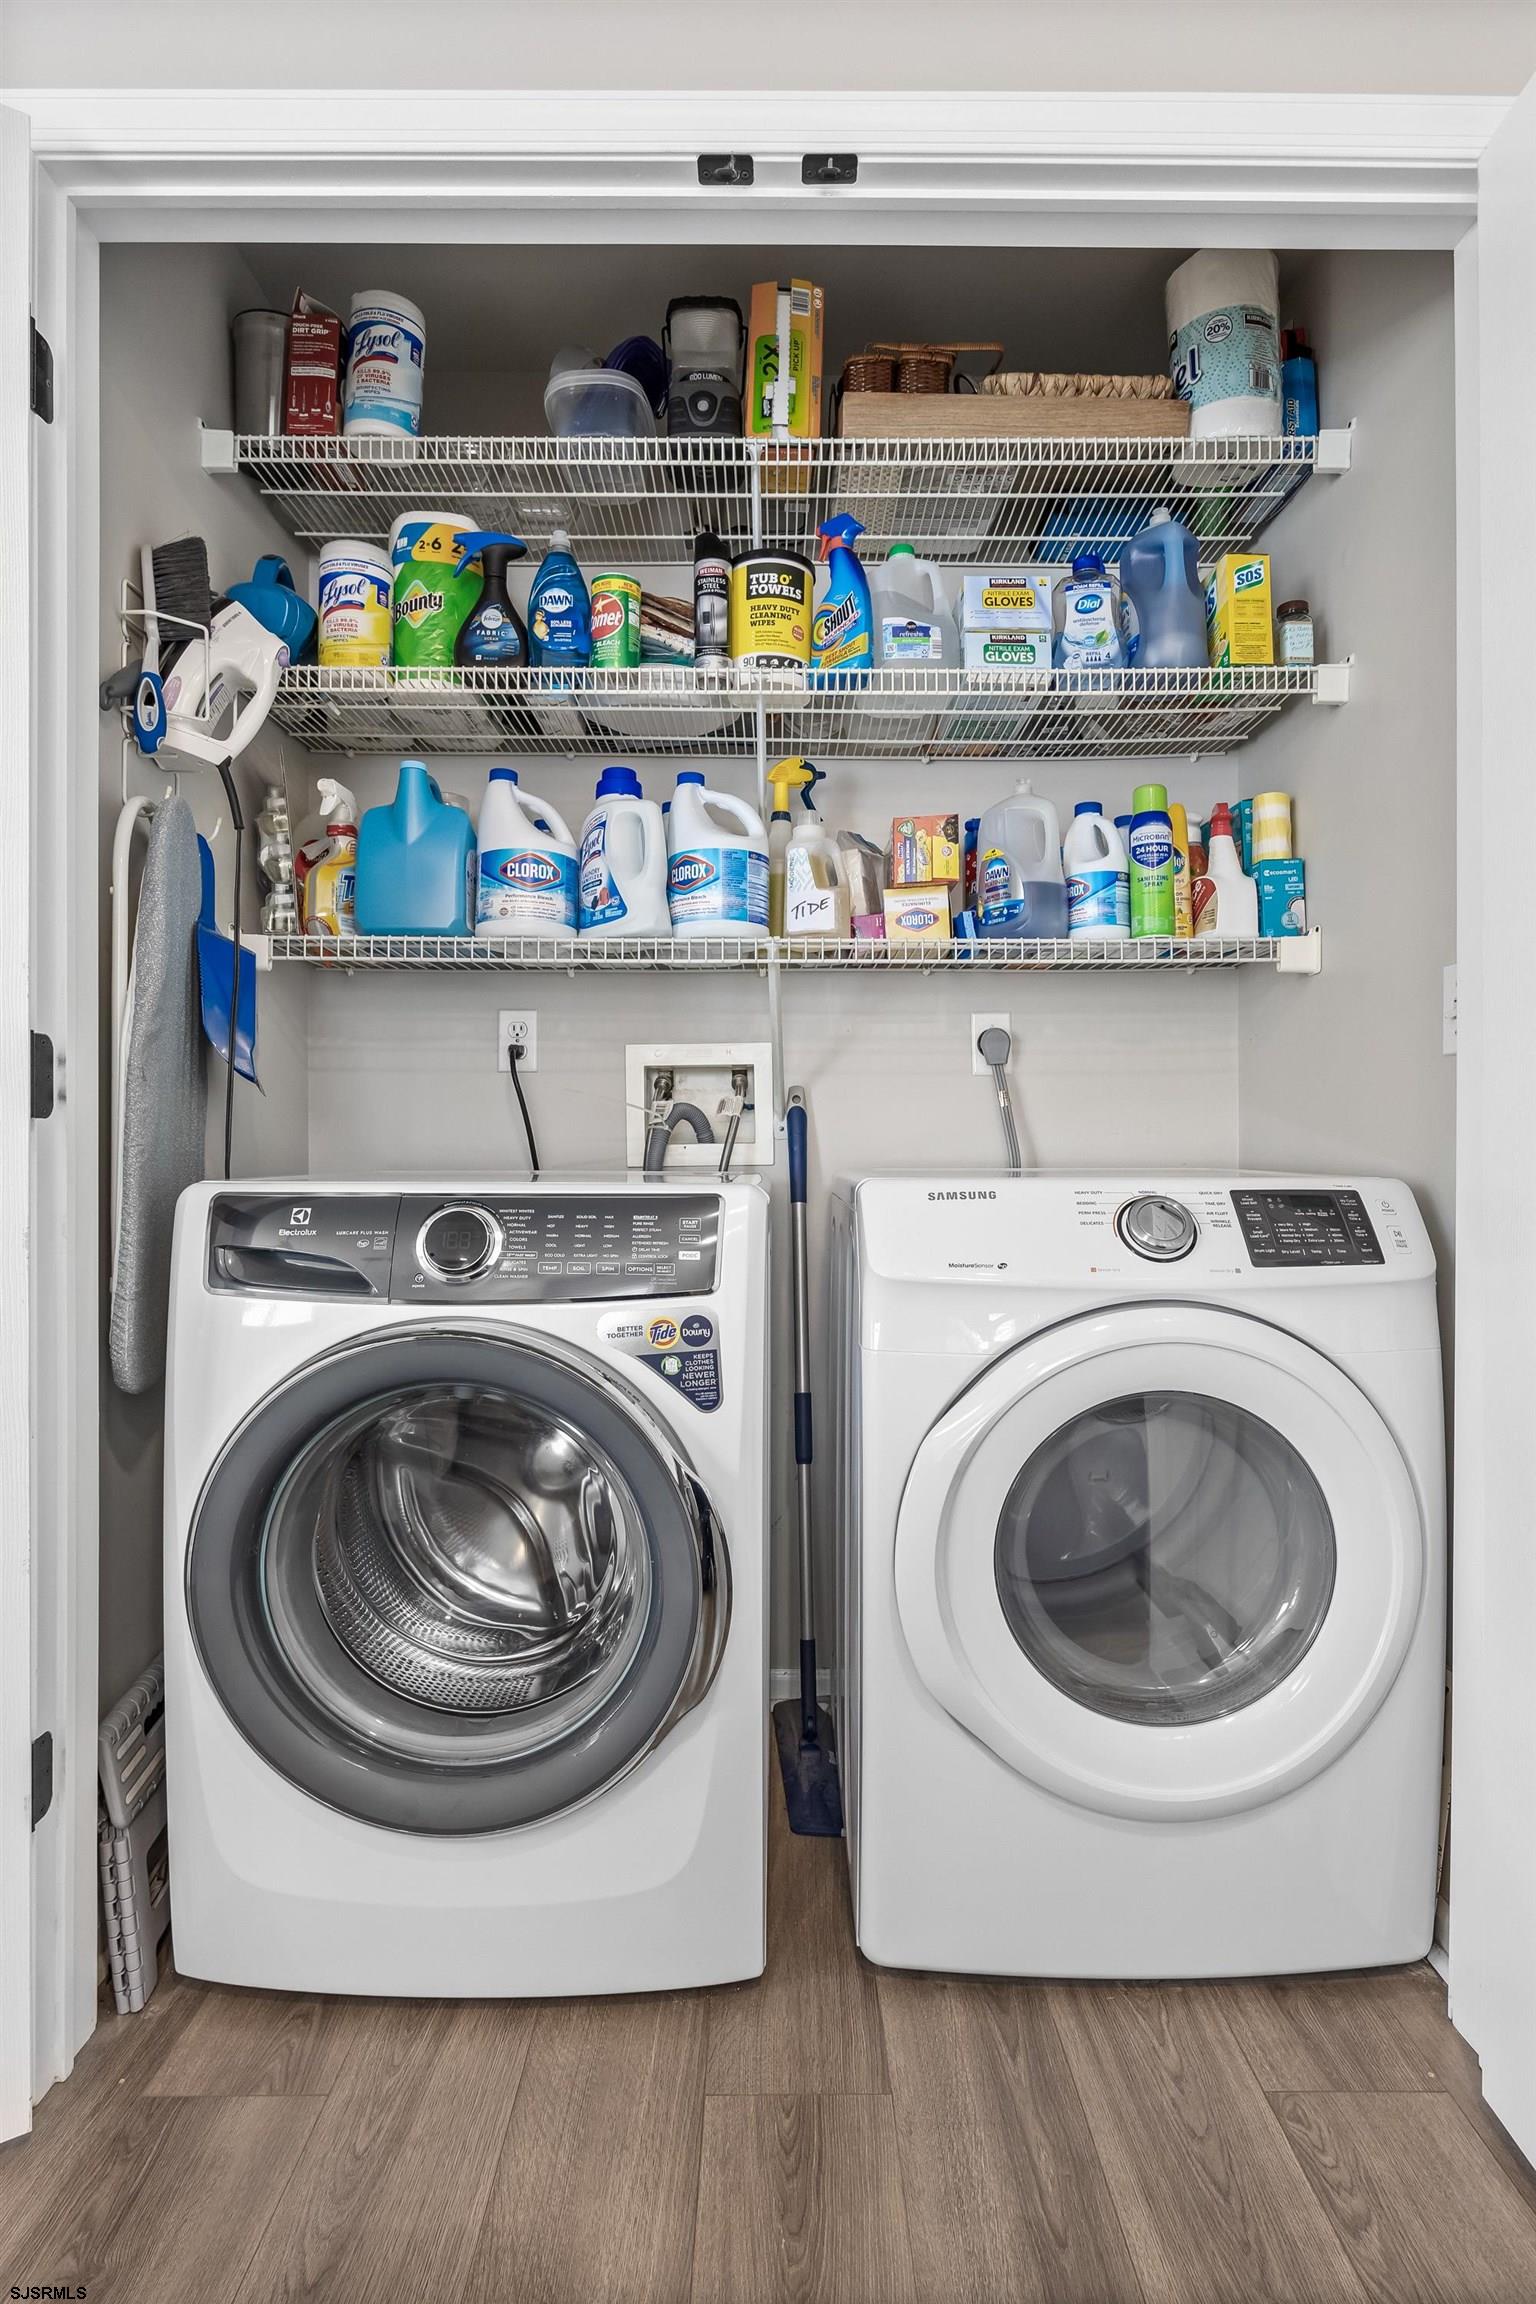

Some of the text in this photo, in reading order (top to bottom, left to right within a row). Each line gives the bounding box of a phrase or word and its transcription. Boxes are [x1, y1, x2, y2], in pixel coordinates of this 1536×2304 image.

[1206, 322, 1231, 337] 20%
[355, 329, 401, 358] Lysol
[794, 339, 800, 351] UP
[697, 577, 726, 586] STAINLESS
[749, 573, 779, 585] TUB
[323, 579, 366, 608] Lysol
[749, 583, 803, 600] TOWELS
[540, 594, 573, 606] DAWN
[984, 597, 1033, 607] GLOVES
[1077, 598, 1101, 610] Dial
[395, 592, 443, 623] Bounty
[750, 604, 800, 616] HEAVY DUTY
[750, 612, 792, 621] CLEANING
[824, 593, 855, 637] SHOUT
[750, 619, 776, 627] WIPES
[476, 629, 506, 637] FABRIC
[985, 652, 1034, 662] GLOVES
[1135, 845, 1169, 854] 24 HOUR
[507, 862, 554, 881] CLOROX
[671, 863, 707, 883] CLOROX
[985, 867, 1009, 881] DAWN
[790, 897, 831, 920] TIDE
[901, 913, 934, 926] CLOROX
[927, 1190, 997, 1201] SAMSUNG
[278, 1228, 317, 1237] Electrolux
[607, 1331, 644, 1339] TOGETHER
[649, 1324, 711, 1345] Tide Downy
[685, 1358, 714, 1366] CLOTHES
[682, 1371, 715, 1380] NEWER
